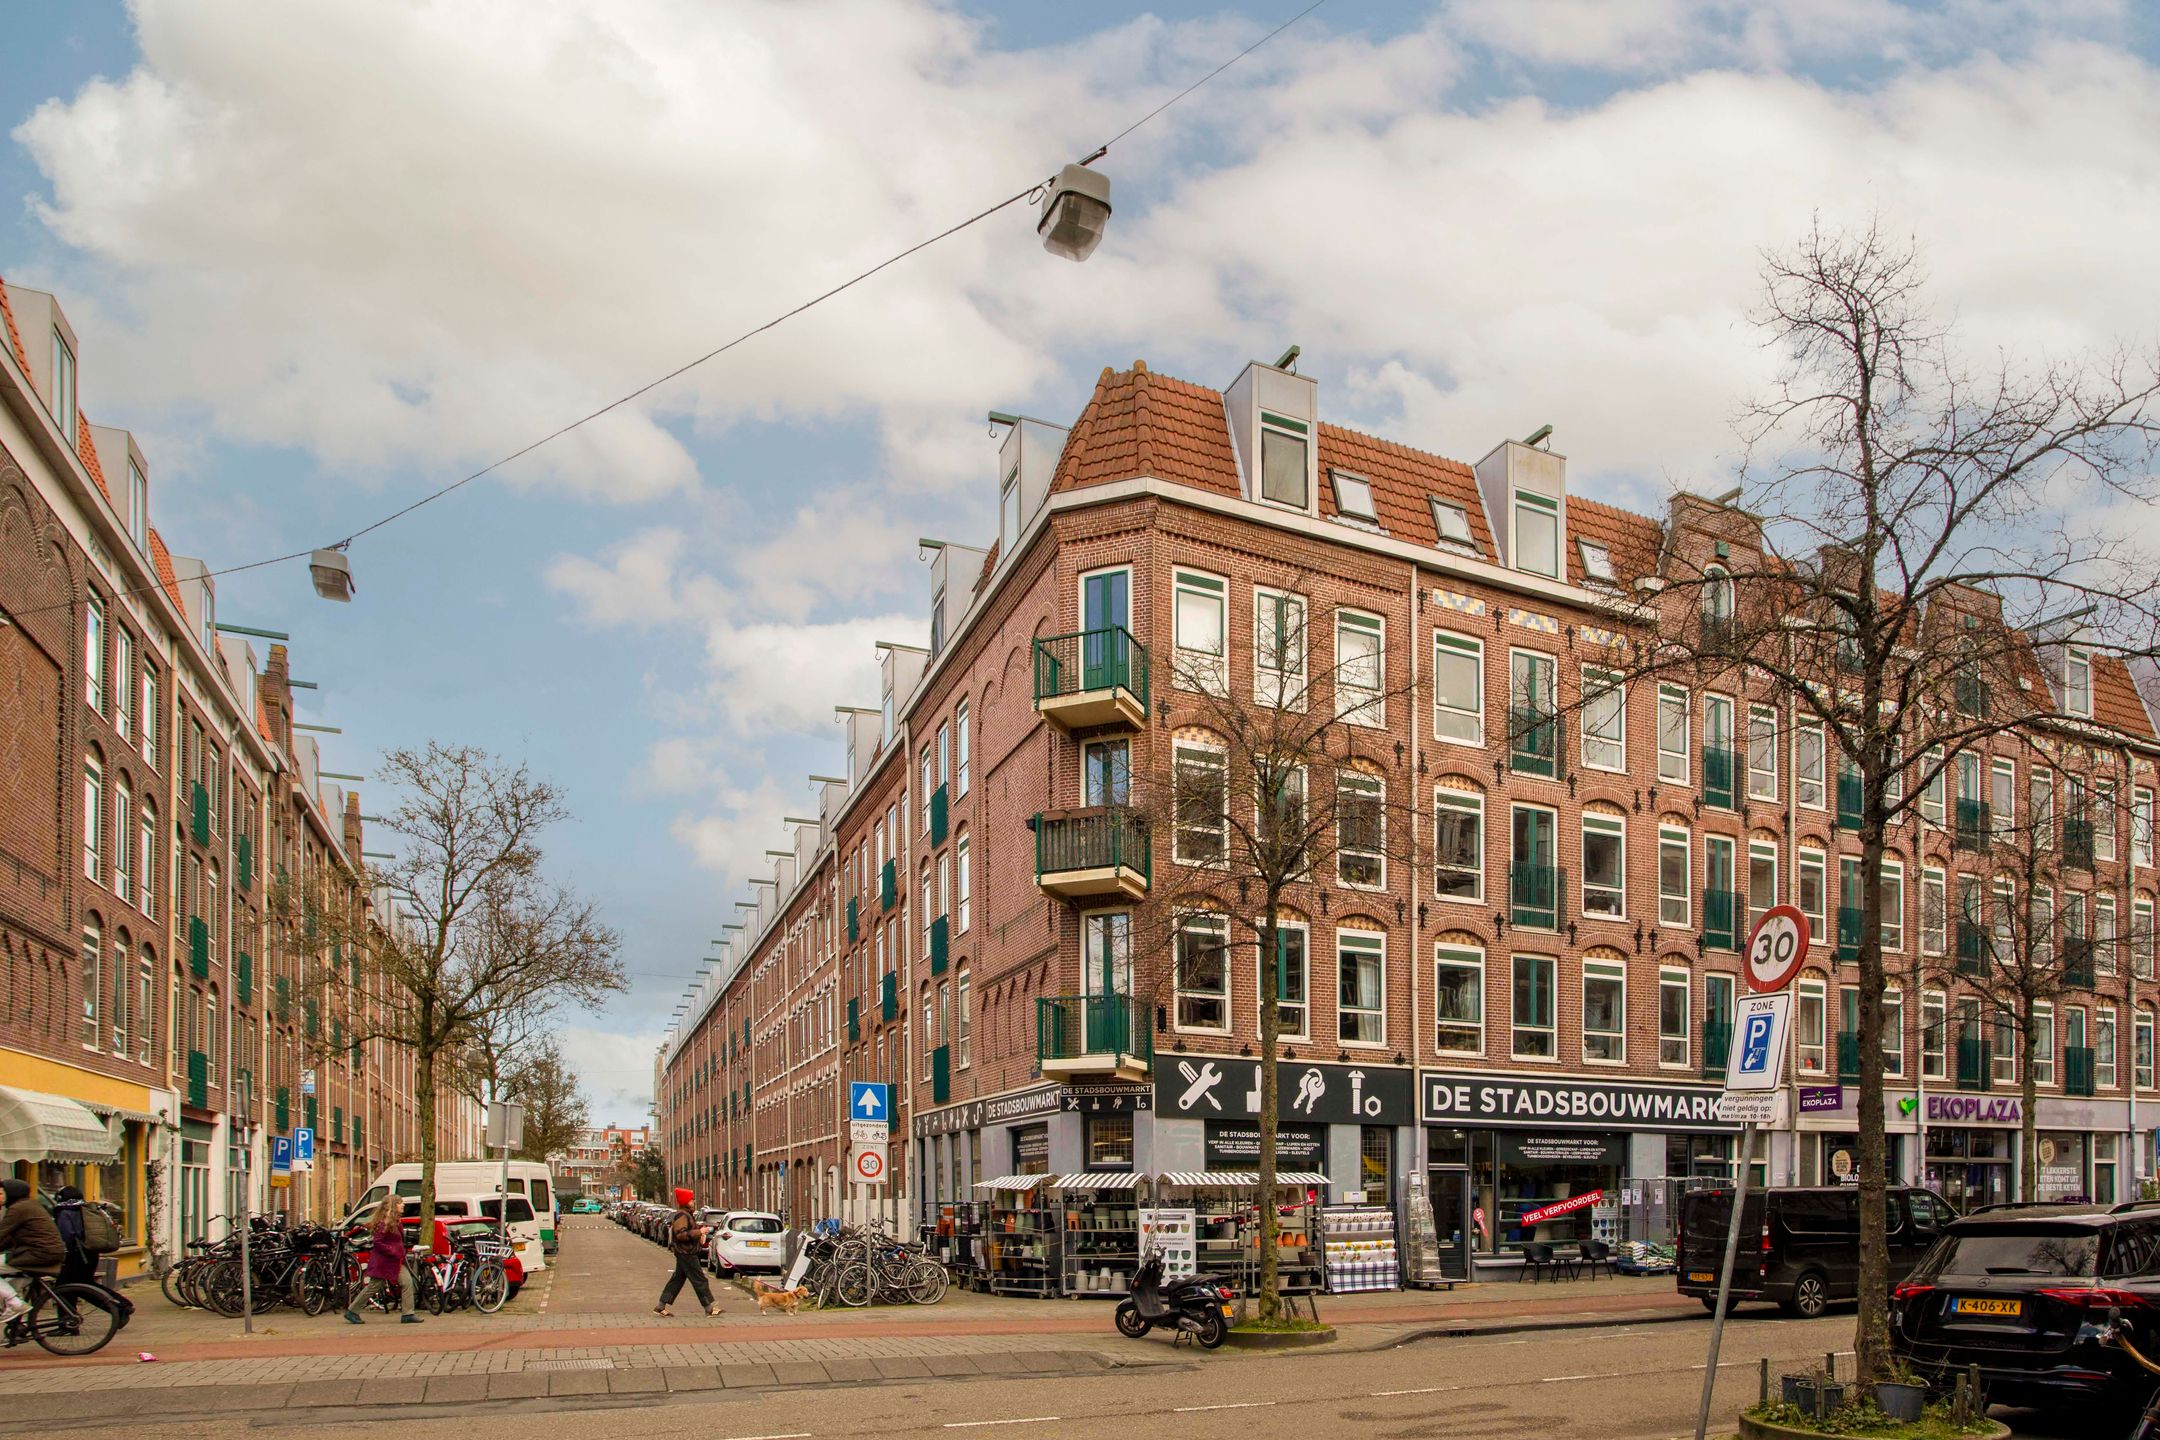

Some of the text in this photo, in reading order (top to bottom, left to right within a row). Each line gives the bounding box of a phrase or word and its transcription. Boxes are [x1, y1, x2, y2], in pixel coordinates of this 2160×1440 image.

[1754, 930, 1794, 965] 30
[1750, 1000, 1775, 1012] ZONE
[1749, 1020, 1767, 1048] P
[1062, 1086, 1150, 1095] DE STADSBOUWMARKT
[988, 1090, 1060, 1118] DE STADSBOUWMARKT
[1432, 1084, 1722, 1121] DE STADSBOUWMARK
[1724, 1095, 1773, 1104] vergunningen
[1802, 1098, 1837, 1106] EKOPLAZA
[1928, 1096, 2020, 1120] EKOPLAZA
[298, 1130, 309, 1146] P
[278, 1140, 288, 1156] P
[863, 1160, 878, 1170] 30
[1524, 1212, 1543, 1222] VEEL
[1543, 1193, 1600, 1216] VERFVOORDEEL
[1960, 1300, 2017, 1313] K-406-XK
